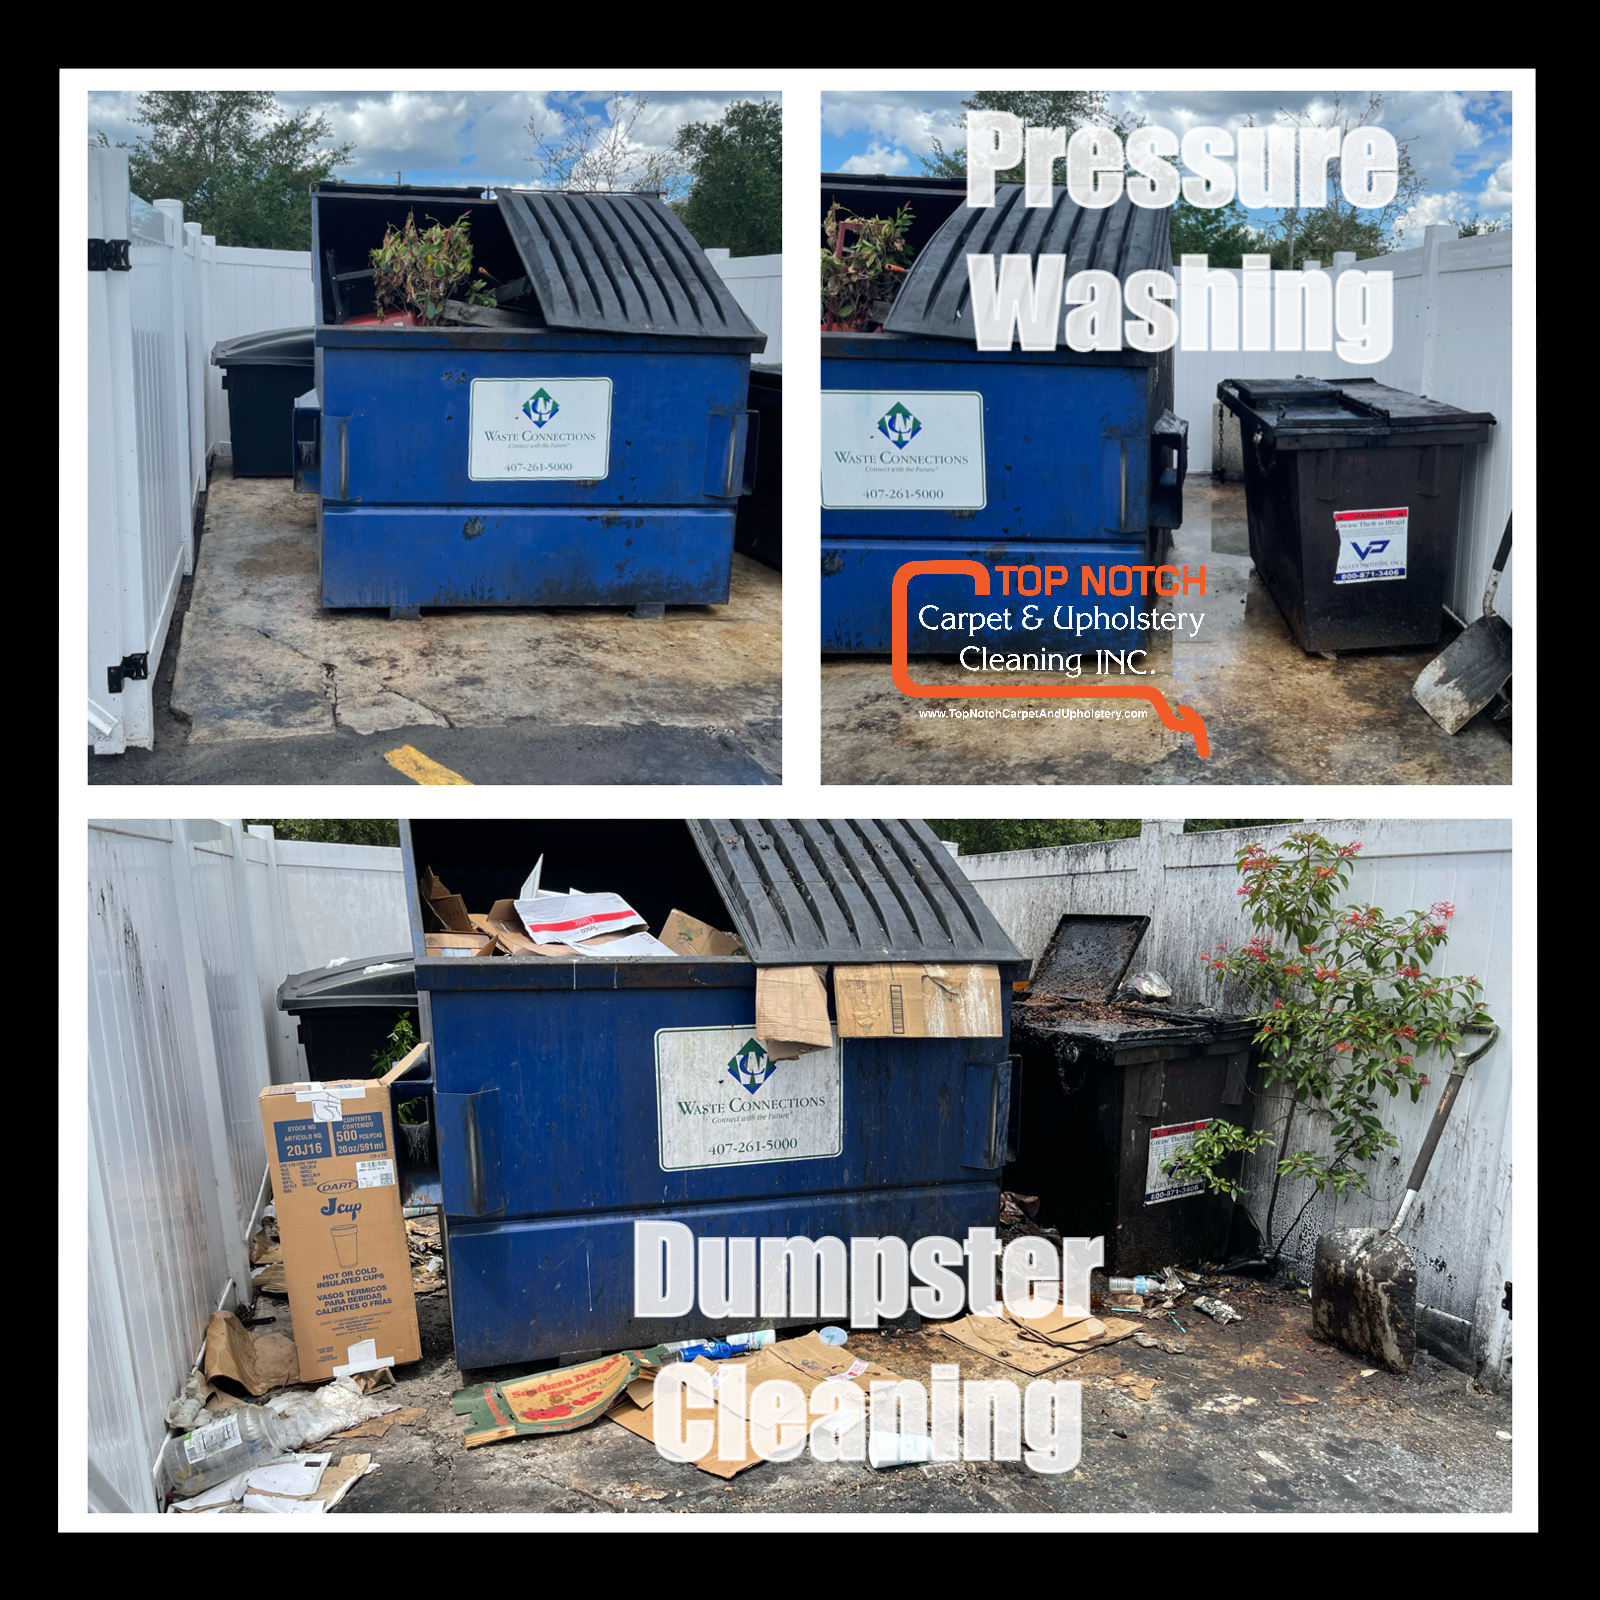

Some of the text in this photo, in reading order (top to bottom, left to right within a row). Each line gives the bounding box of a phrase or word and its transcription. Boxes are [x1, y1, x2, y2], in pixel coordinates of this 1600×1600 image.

[504, 463, 573, 472] 407-261-5000
[863, 489, 944, 499] 407-261-5000
[1385, 519, 1405, 527] Illegal
[1341, 569, 1399, 580] 800-871-3406
[343, 1115, 372, 1123] CONTENTS
[712, 1116, 740, 1124] Connect
[342, 1122, 374, 1130] CONTENIDO
[336, 1129, 357, 1142] 500
[287, 1143, 323, 1157] 20J16
[708, 1137, 798, 1155] 407-261-5000
[322, 1181, 353, 1192] DART
[355, 1267, 377, 1276] COLD
[317, 1273, 385, 1289] INSULATED CUPS
[317, 1284, 387, 1301] VASOS TÉRMICOS
[324, 1293, 382, 1307] PARA BEBIDAS
[315, 1303, 360, 1315] CALIENTES
[511, 1376, 573, 1398] Southern
